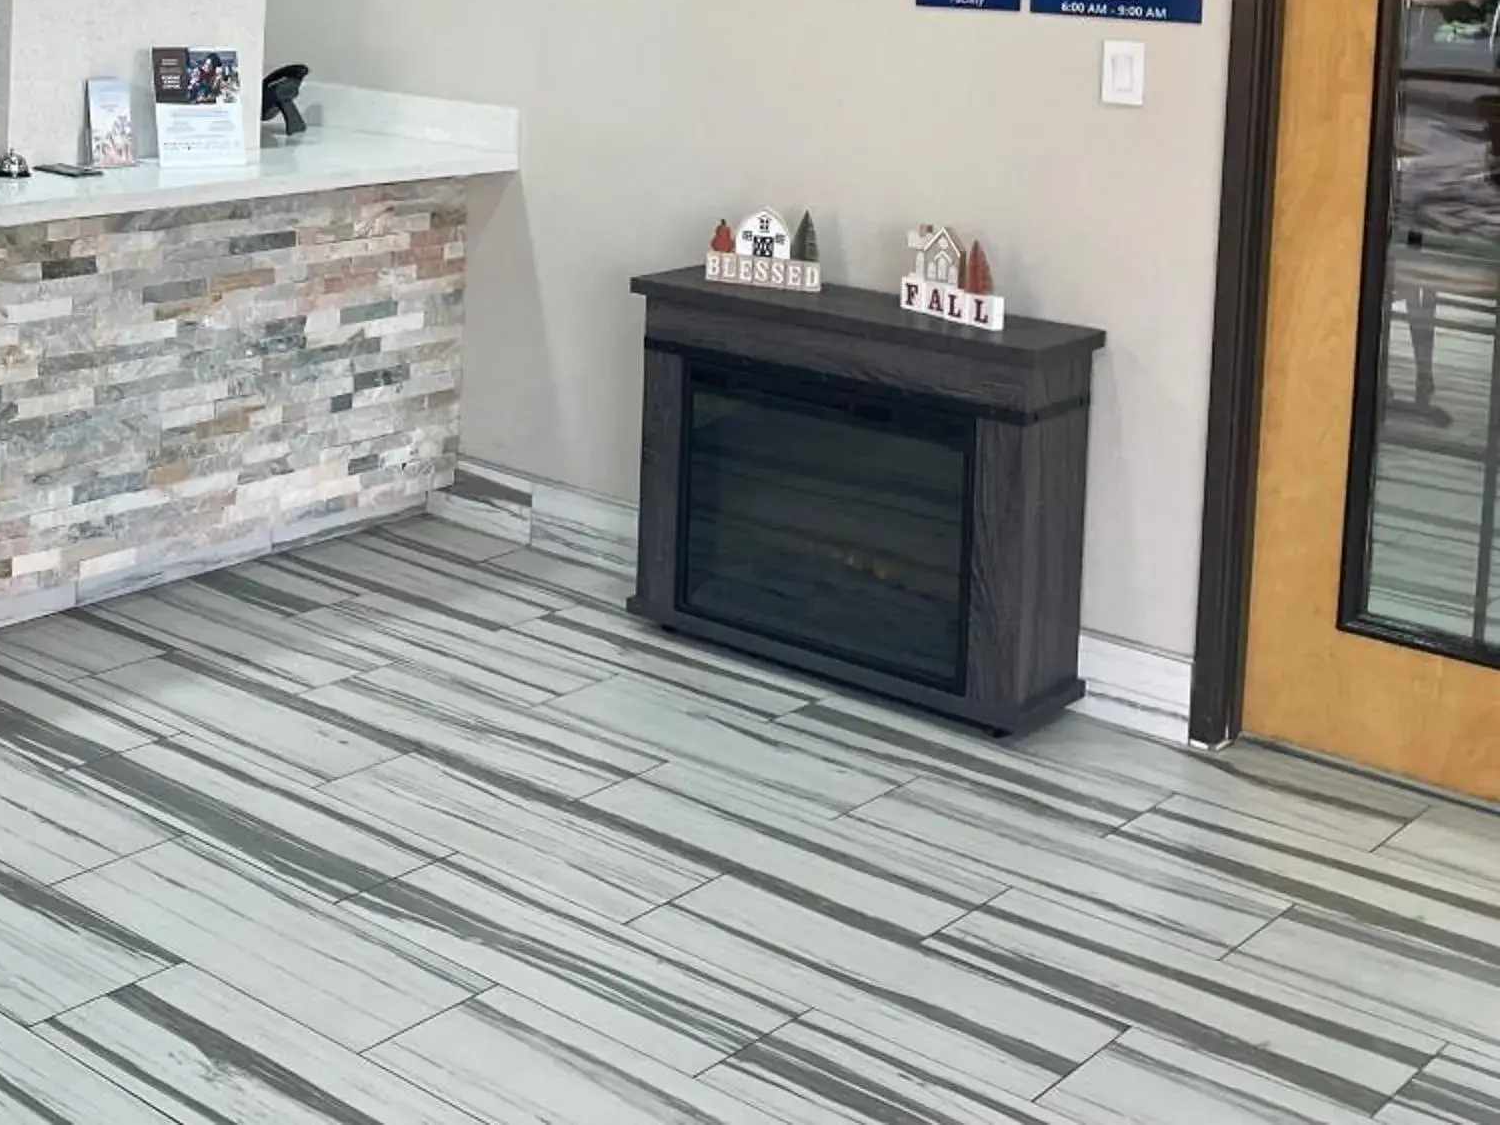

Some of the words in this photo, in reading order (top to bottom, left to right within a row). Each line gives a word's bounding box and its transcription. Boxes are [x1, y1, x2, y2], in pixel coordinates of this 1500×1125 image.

[1061, 2, 1085, 13] 6:00
[1087, 3, 1107, 14] AM
[1117, 5, 1143, 17] 9:00
[1145, 6, 1167, 19] AM
[706, 254, 819, 287] BLESSED
[905, 282, 989, 324] FALL
